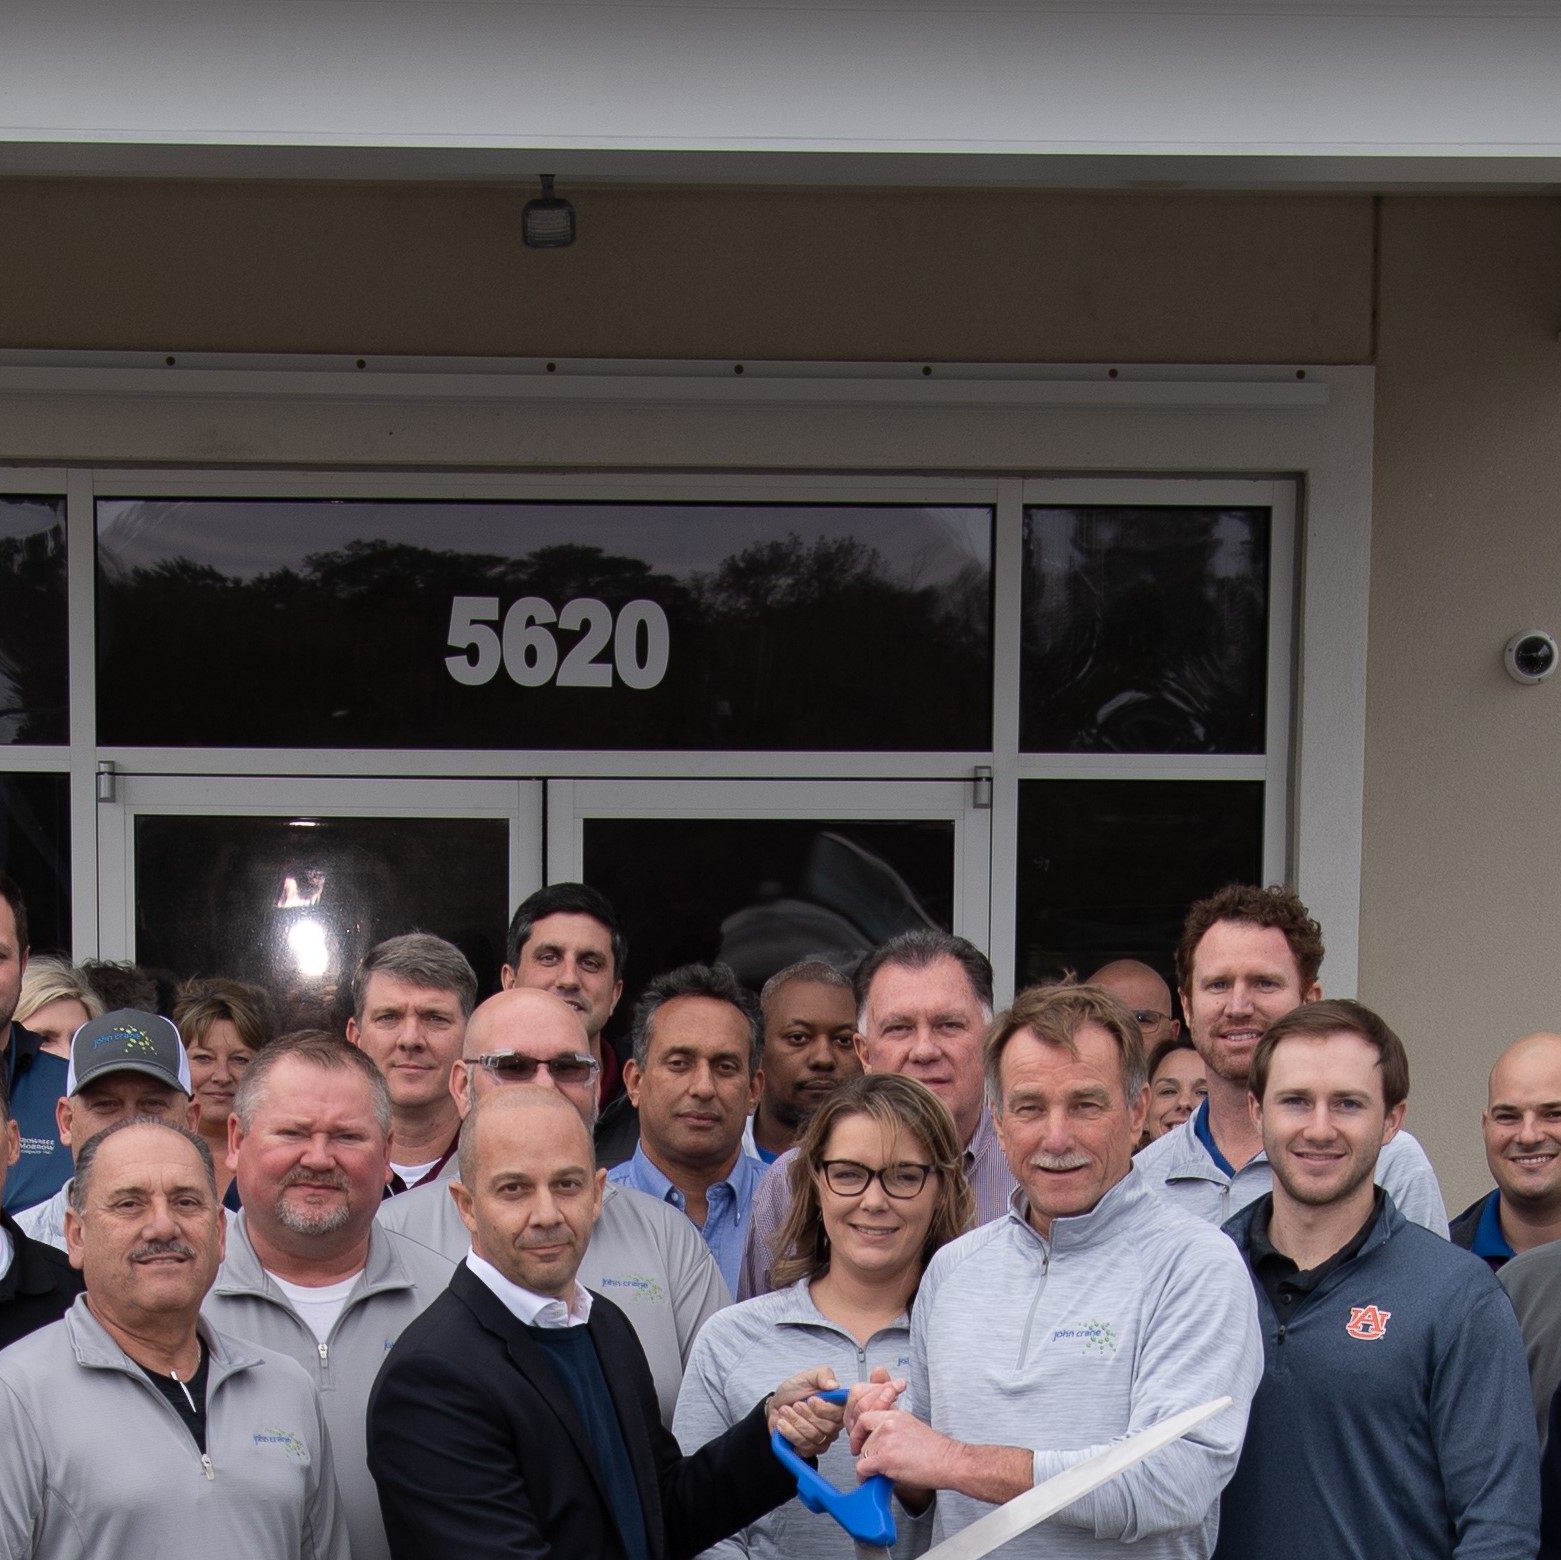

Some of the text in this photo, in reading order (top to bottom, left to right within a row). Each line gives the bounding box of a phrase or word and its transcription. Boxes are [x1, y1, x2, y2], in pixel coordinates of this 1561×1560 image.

[445, 596, 670, 689] 5620
[93, 1032, 141, 1049] john crane
[601, 1278, 649, 1289] john crane
[1052, 1329, 1102, 1343] john crane
